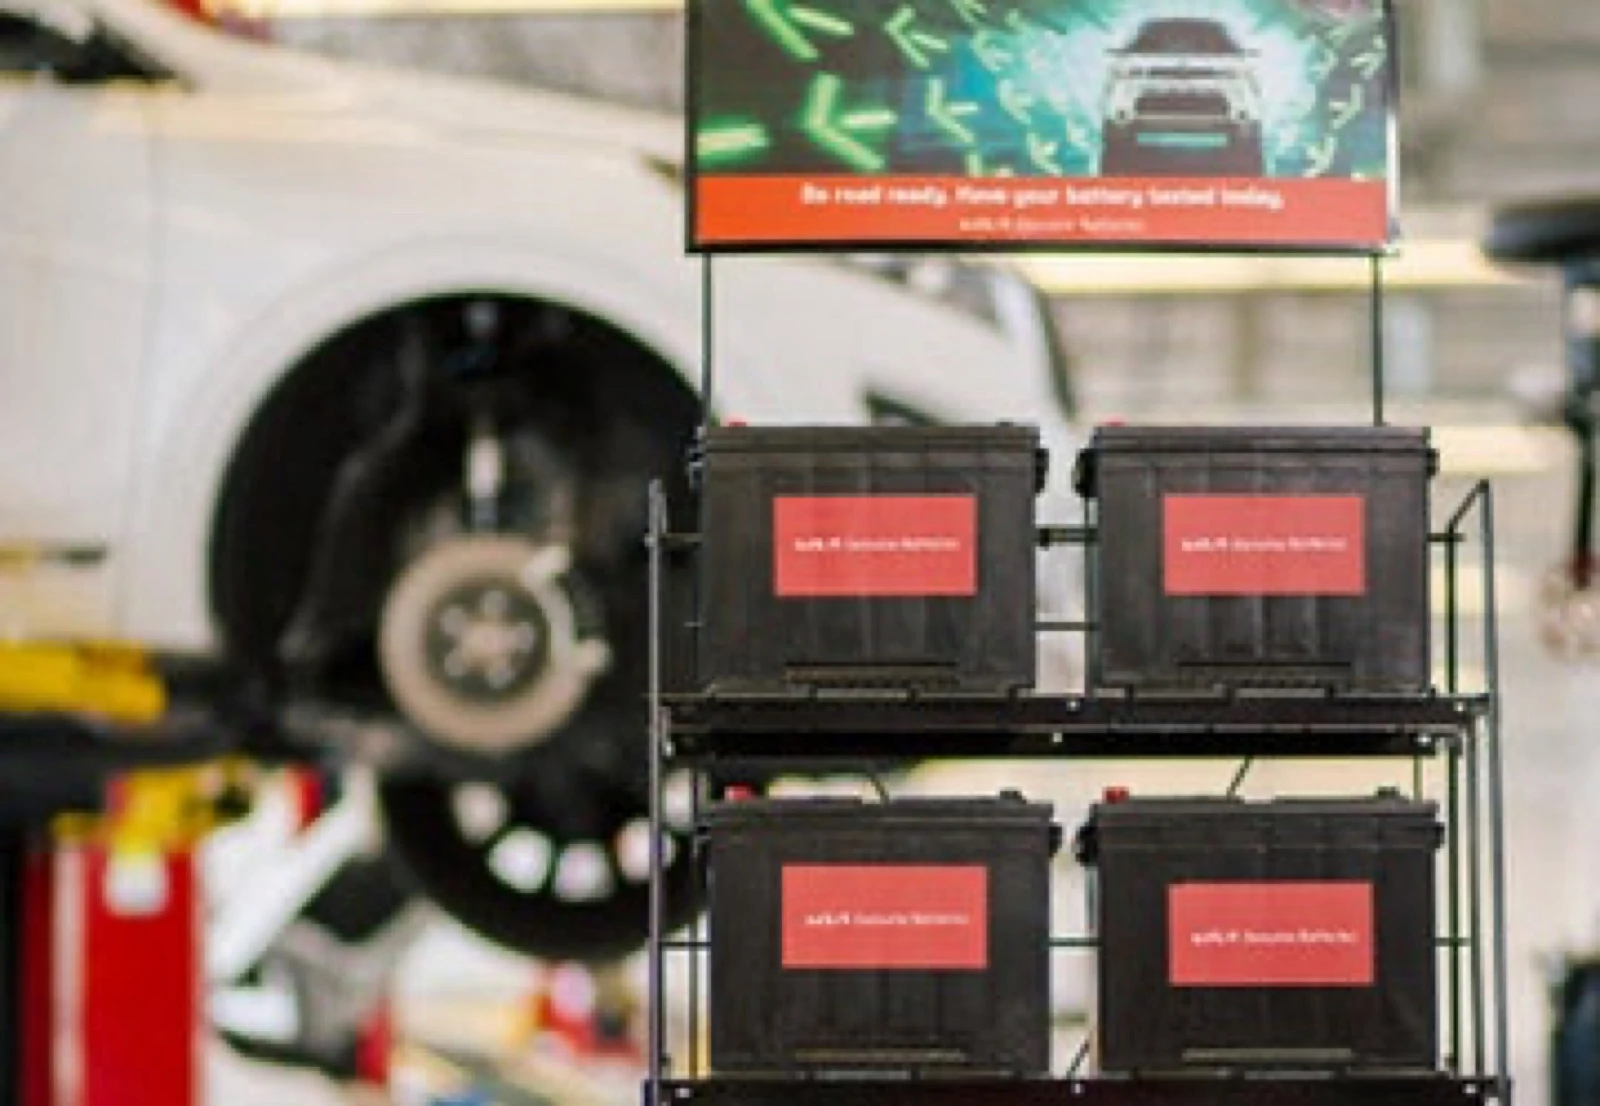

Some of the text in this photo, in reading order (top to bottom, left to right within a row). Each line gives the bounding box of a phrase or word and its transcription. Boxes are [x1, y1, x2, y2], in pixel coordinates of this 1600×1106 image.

[1013, 188, 1058, 209] your
[1066, 185, 1142, 209] battery
[1147, 185, 1214, 205] tested
